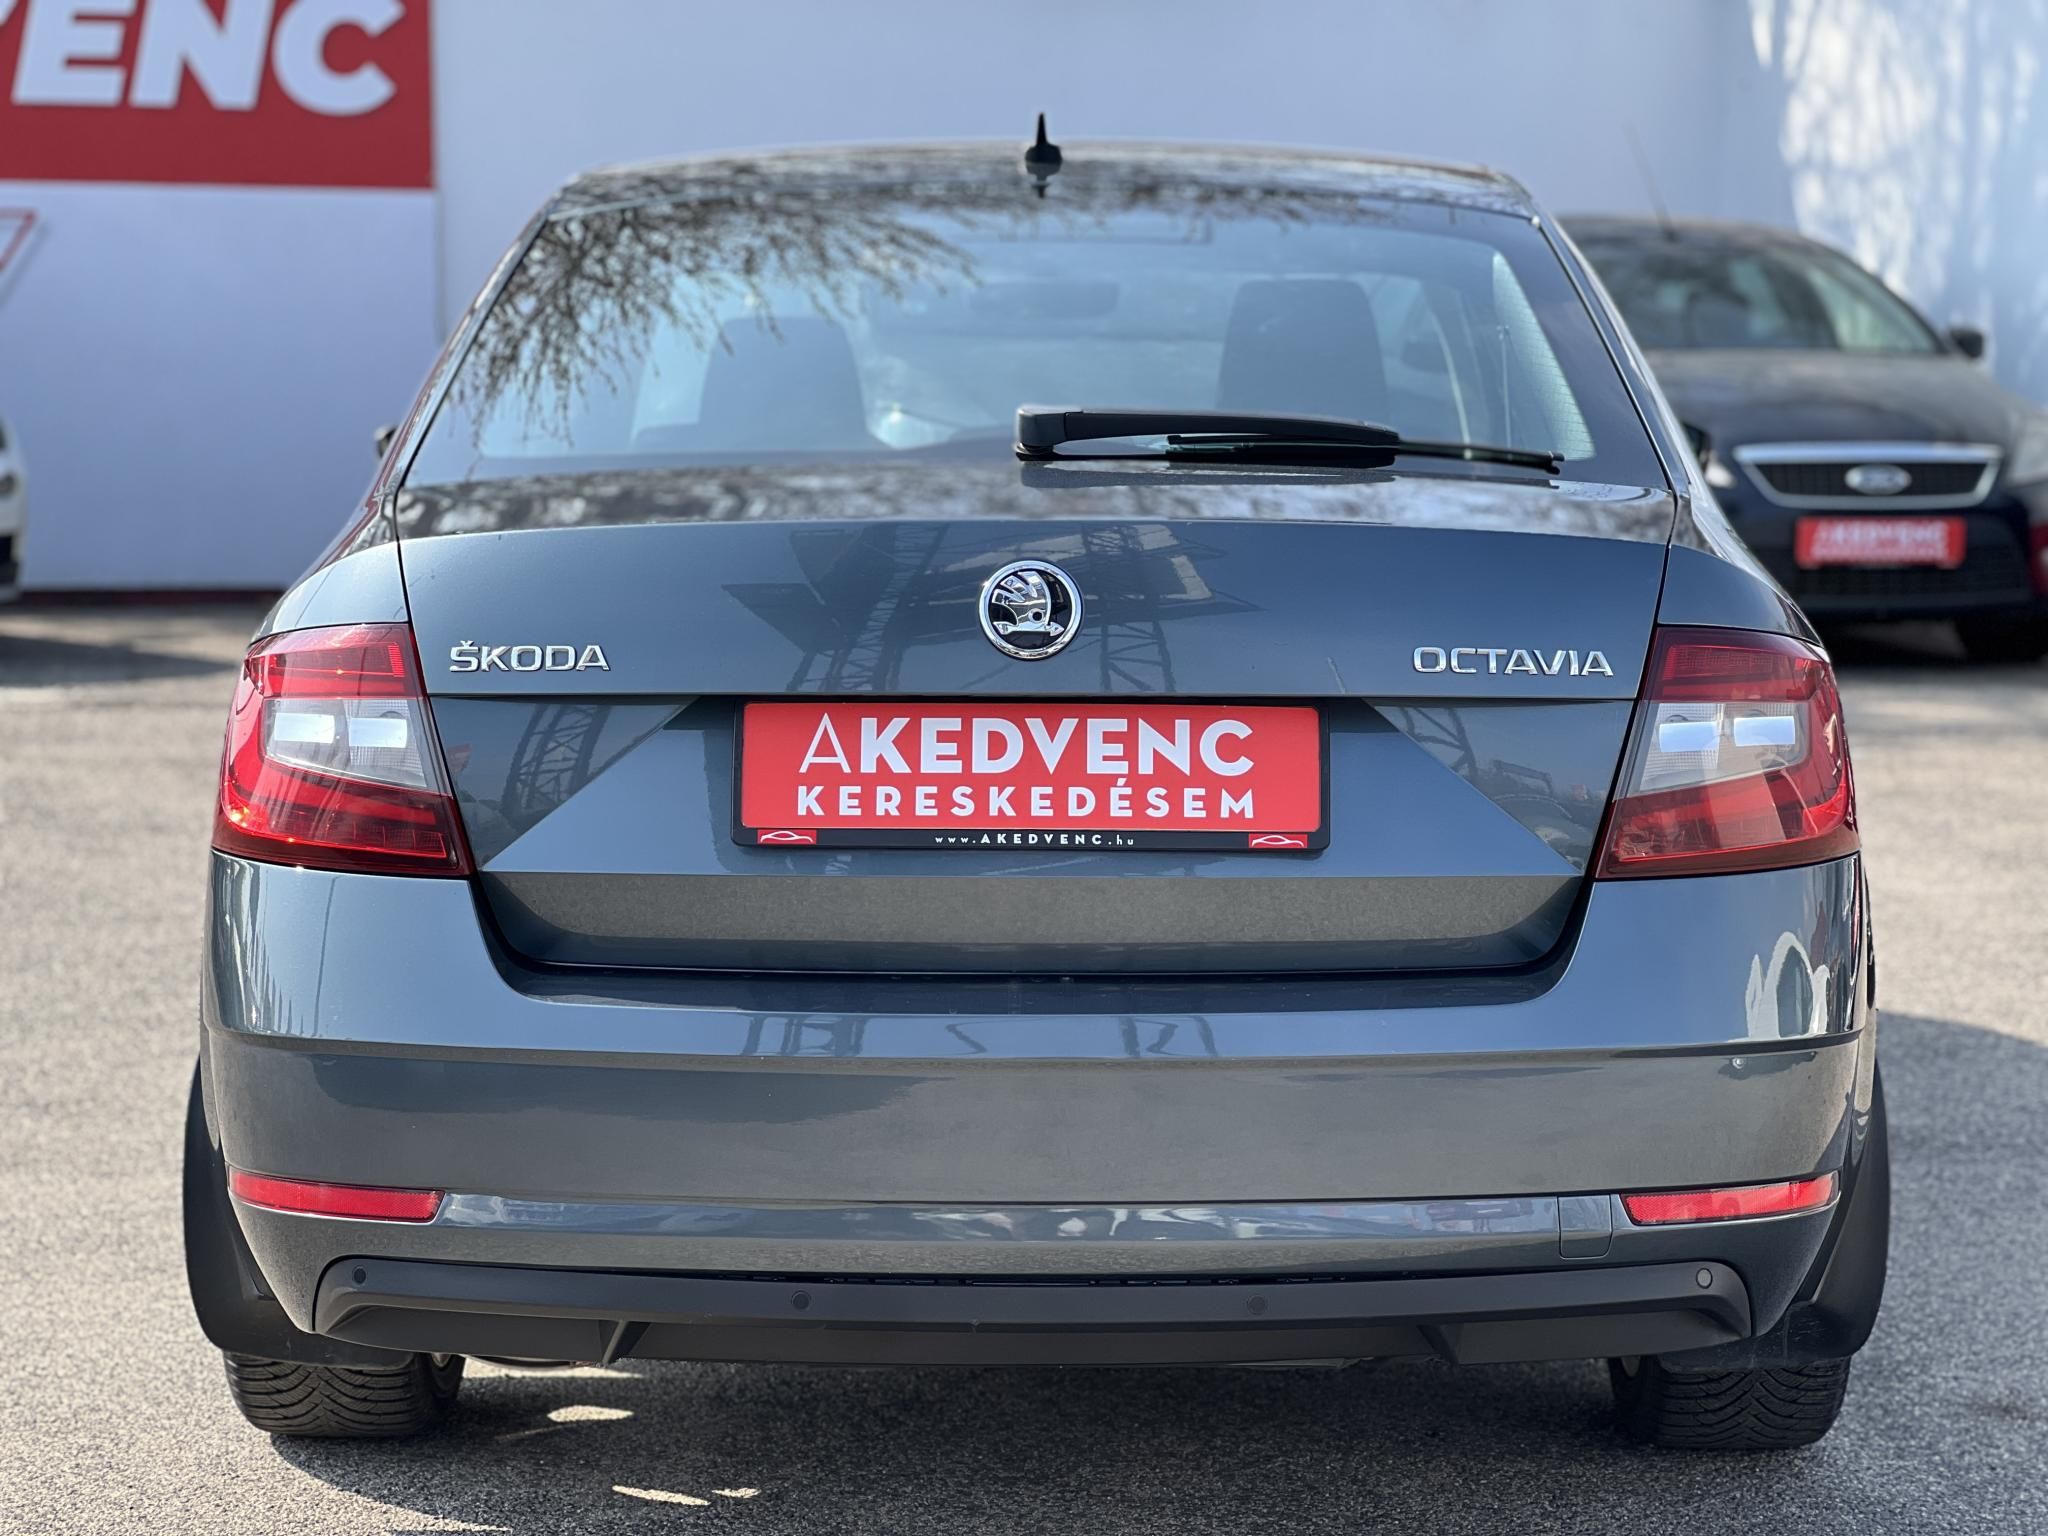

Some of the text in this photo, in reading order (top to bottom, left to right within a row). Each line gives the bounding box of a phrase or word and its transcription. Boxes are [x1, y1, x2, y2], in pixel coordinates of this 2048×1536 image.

[0, 0, 405, 116] ENC
[449, 640, 610, 672] ŠKODA
[1413, 646, 1614, 676] OCTAVIA
[799, 712, 1254, 776] AKEDVENC
[797, 779, 1254, 819] KERESKEDÉSEM
[935, 833, 1134, 846] www.AKEDVENC.hu
